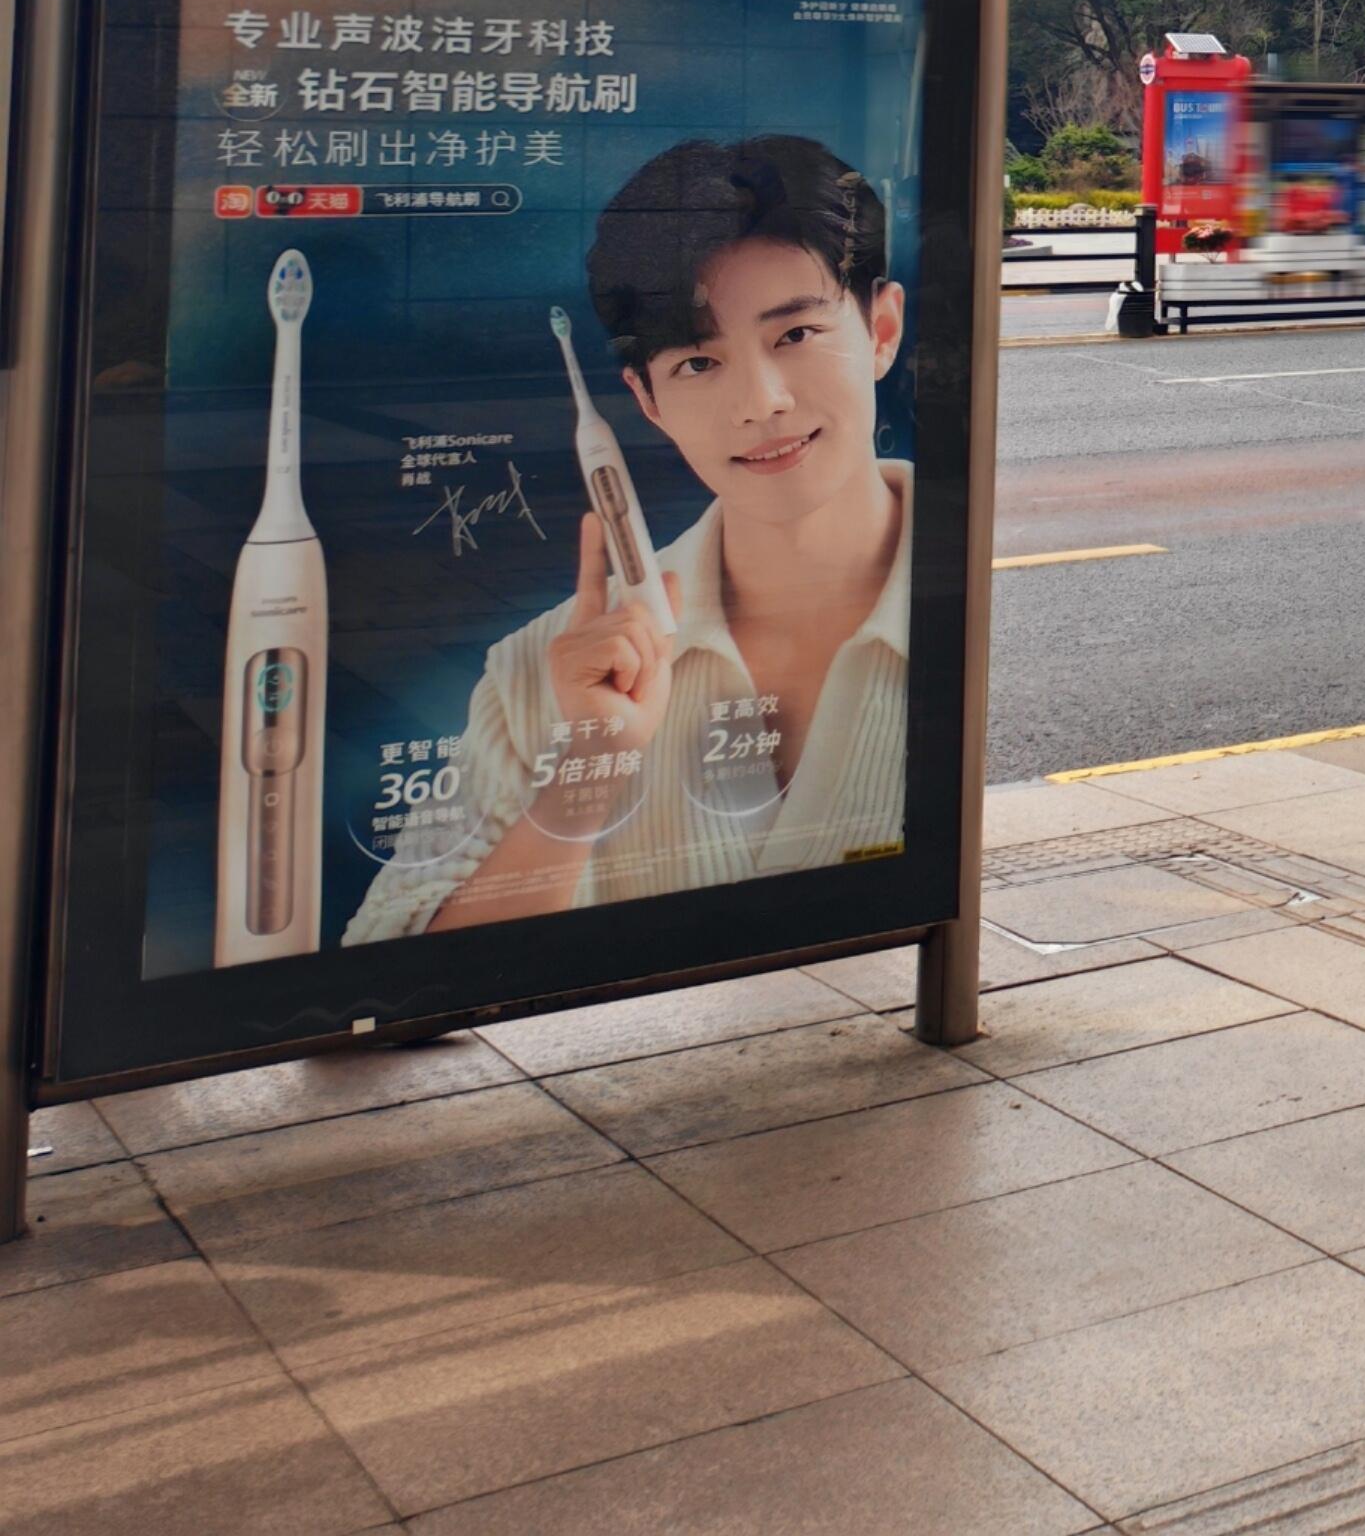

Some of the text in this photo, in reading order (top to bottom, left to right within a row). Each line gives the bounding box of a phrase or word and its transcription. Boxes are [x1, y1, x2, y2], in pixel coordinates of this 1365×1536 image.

[224, 9, 616, 57] 专业声波洁牙科技
[233, 69, 267, 81] NEW
[222, 83, 278, 109] 全新
[298, 68, 637, 114] 钻石智能导航刷
[217, 127, 564, 167] 轻松刷出净护美
[308, 193, 350, 211] 天猫
[376, 192, 481, 208] 飞利浦导航刷
[710, 694, 779, 722] 更高效
[550, 715, 625, 744] 更干净
[379, 735, 461, 766] 更智能
[703, 729, 782, 763] 2分钟
[530, 749, 642, 788] 5倍清除
